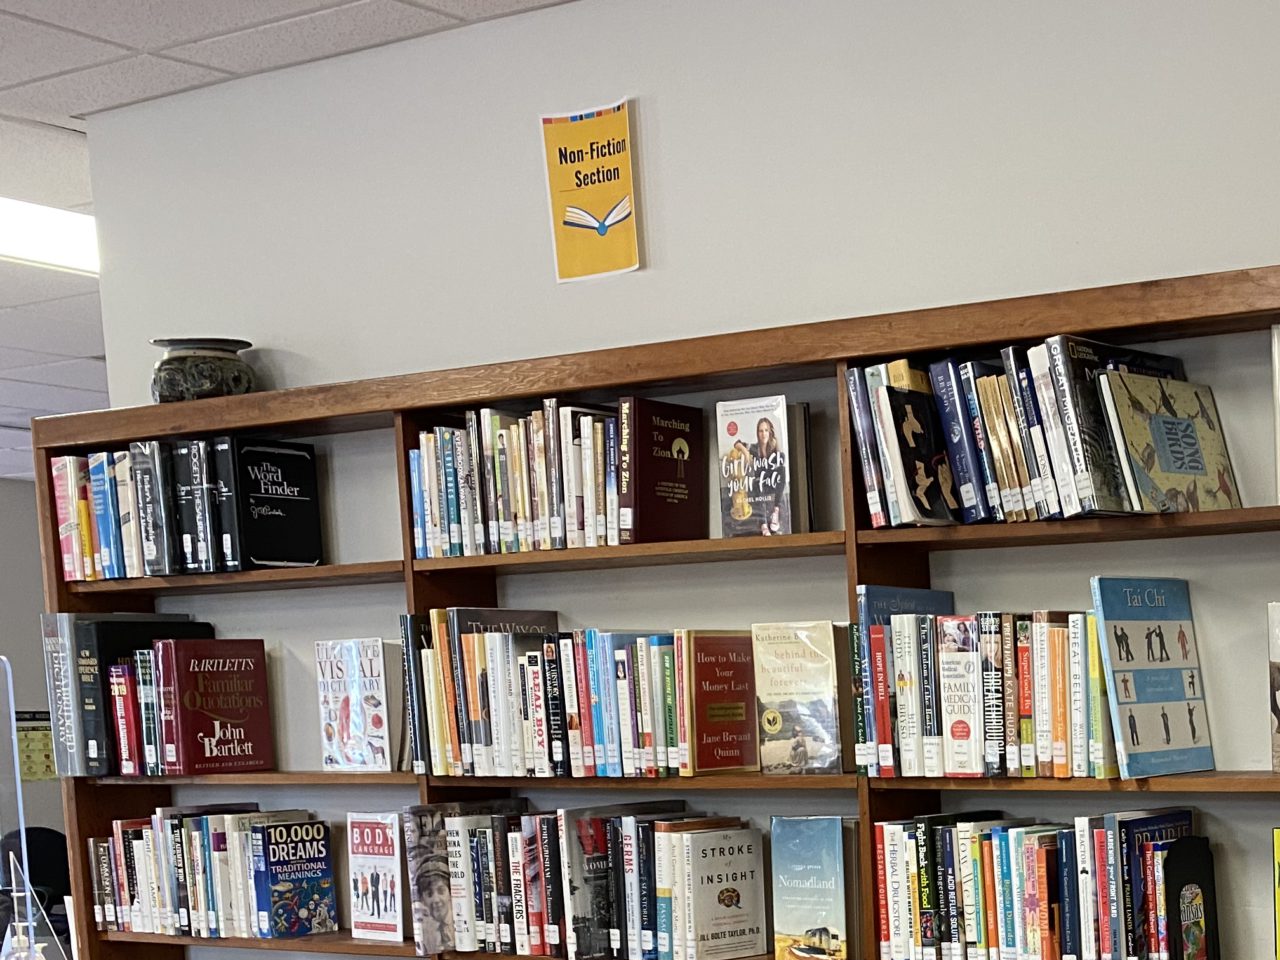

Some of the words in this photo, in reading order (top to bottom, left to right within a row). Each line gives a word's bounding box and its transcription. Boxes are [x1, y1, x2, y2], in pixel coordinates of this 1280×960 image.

[558, 137, 627, 165] Non-Fiction
[574, 166, 620, 188] Section
[652, 416, 690, 432] Marching
[652, 431, 664, 442] To
[652, 446, 672, 458] Zion
[1162, 419, 1187, 471] BIRDS
[1176, 419, 1205, 471] SONG
[262, 462, 277, 472] The
[722, 455, 752, 478] Girl,
[753, 451, 784, 472] wash
[248, 465, 282, 483] Word
[260, 482, 300, 497] Finder
[727, 475, 756, 497] your
[759, 470, 781, 493] face
[1123, 588, 1142, 607] Tai
[1144, 587, 1166, 607] Chi
[755, 633, 791, 642] Katherine
[697, 652, 717, 663] How
[718, 654, 727, 663] to
[728, 652, 751, 663] Make
[715, 668, 733, 677] Your
[196, 675, 255, 693] Familiar
[701, 681, 729, 692] Money
[731, 680, 749, 691] Last
[943, 682, 976, 694] FAMILY
[183, 692, 263, 711] Quotations
[945, 703, 975, 716] GUIDE
[983, 671, 1005, 754] BREAKTHROUGH
[213, 720, 244, 741] John
[203, 738, 254, 758] Bartlett
[713, 748, 740, 759] Quinn
[267, 824, 325, 844] 10,000
[353, 827, 395, 845] BODY
[268, 841, 327, 863] DREAMS
[353, 845, 395, 856] LANGUAGE
[623, 834, 634, 874] GERMS
[701, 844, 754, 859] STROKE
[270, 861, 327, 874] TRADITIONAL
[277, 869, 322, 881] MEANINGS
[701, 870, 756, 885] INSIGHT
[778, 874, 836, 889] Nomadland
